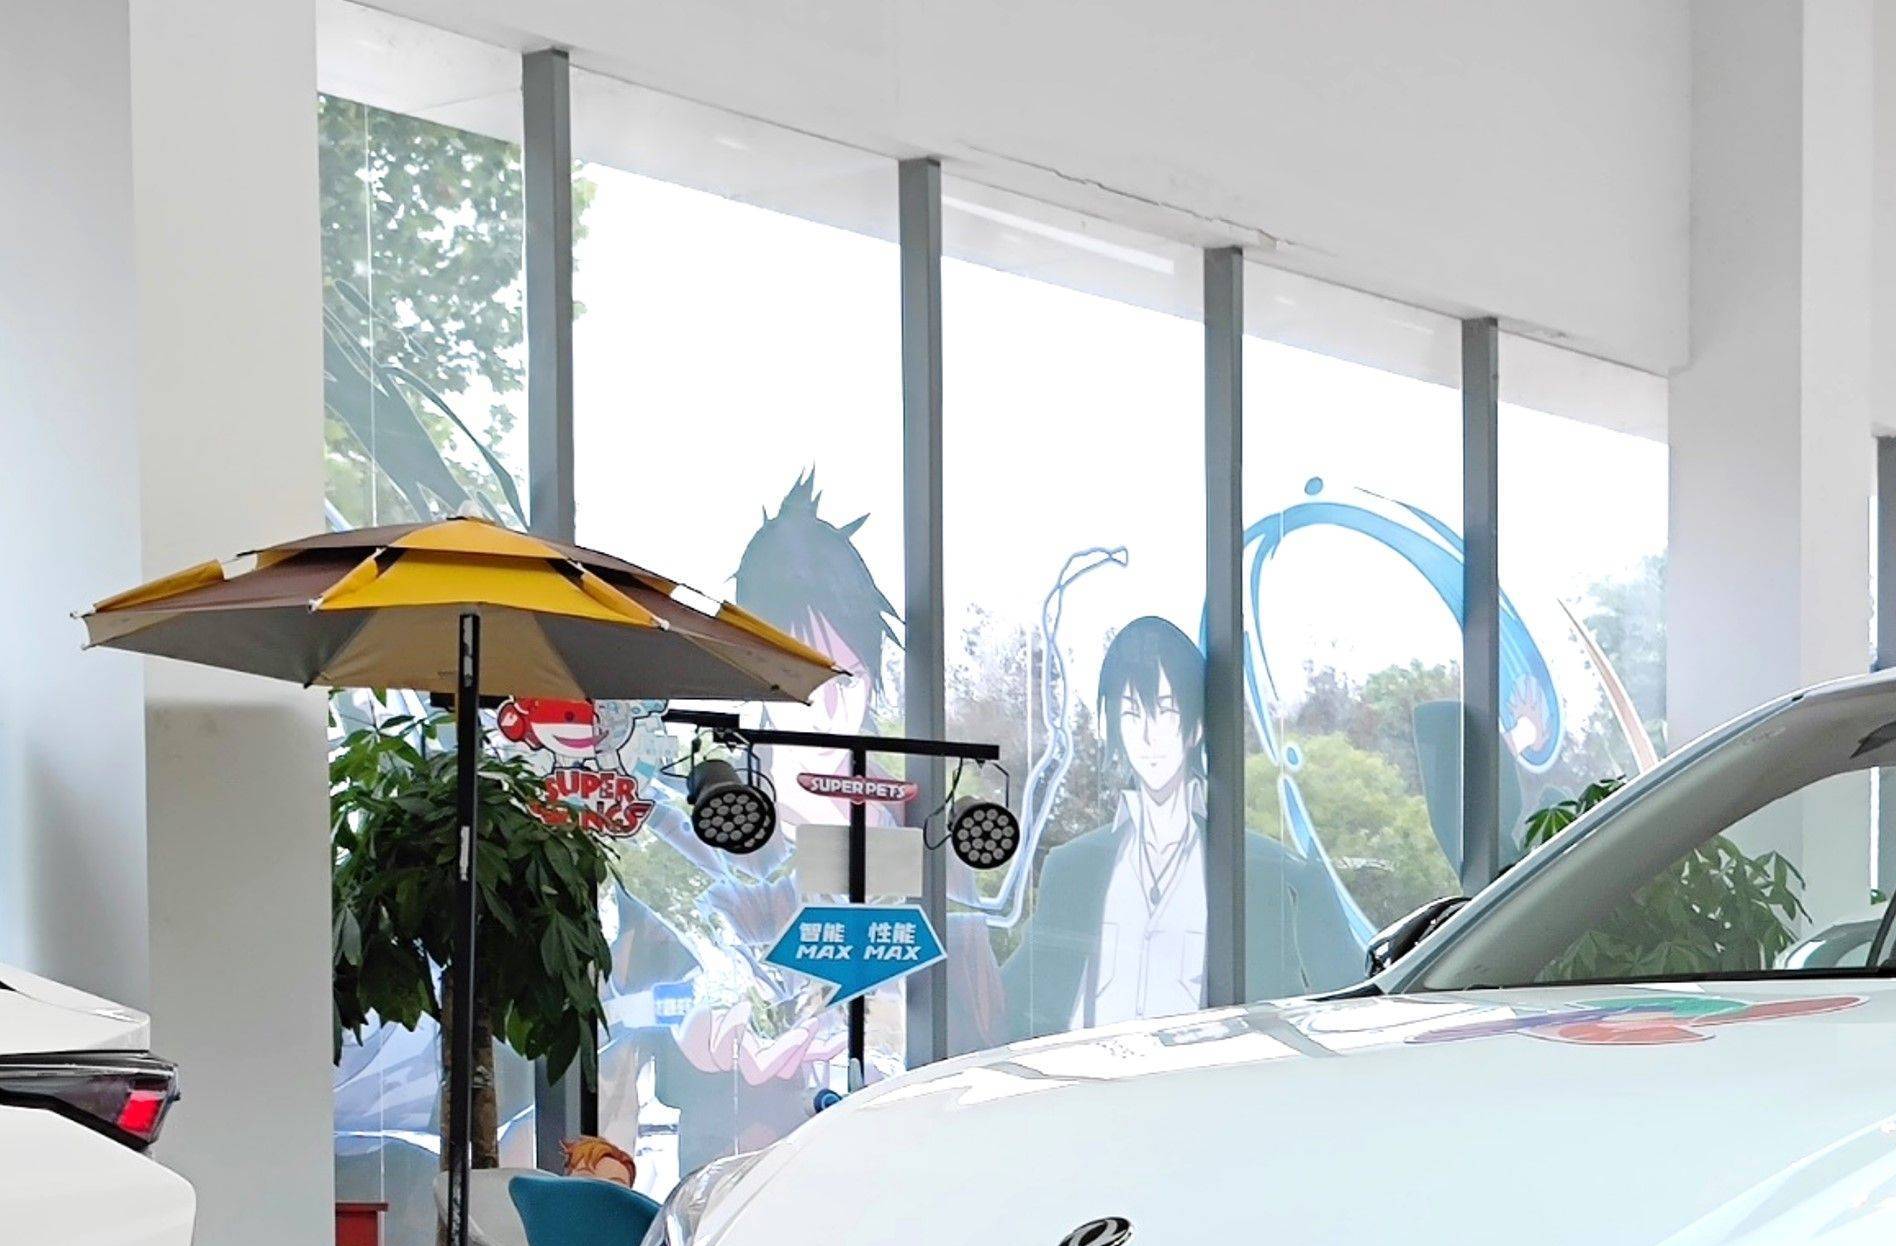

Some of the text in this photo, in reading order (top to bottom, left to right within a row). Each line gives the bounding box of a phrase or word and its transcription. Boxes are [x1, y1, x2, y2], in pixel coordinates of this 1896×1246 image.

[545, 769, 638, 801] SUPER
[811, 777, 906, 798] SUPER PETS
[799, 921, 916, 944] 智能 性能
[795, 944, 922, 961] MAX MAX
